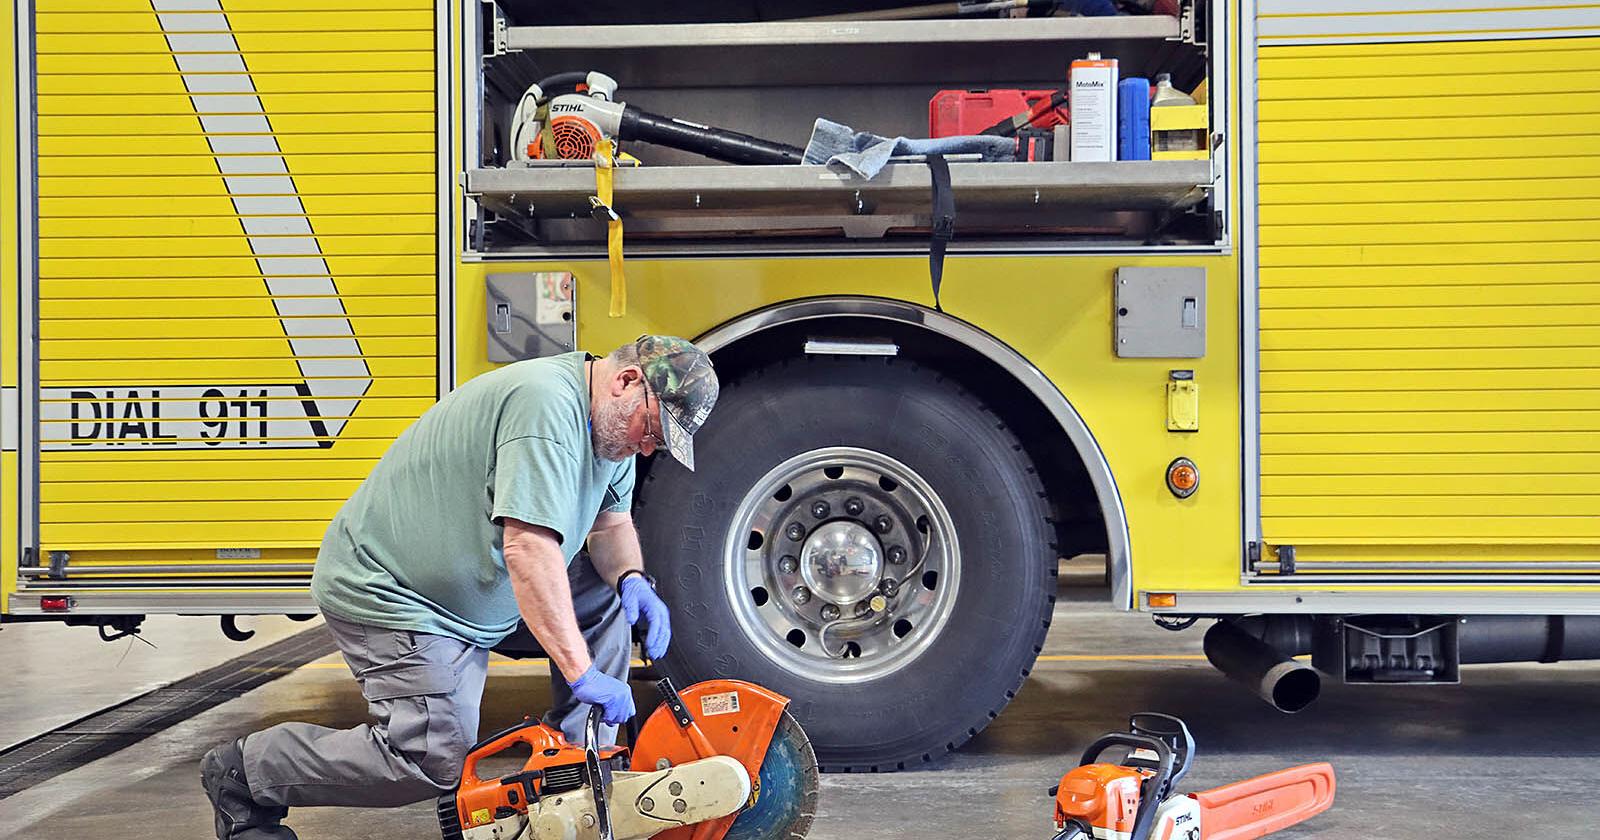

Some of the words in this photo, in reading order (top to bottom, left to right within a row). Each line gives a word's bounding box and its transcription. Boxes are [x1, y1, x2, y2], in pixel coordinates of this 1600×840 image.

[551, 104, 584, 112] STIHL
[71, 390, 177, 446] DIAL
[199, 388, 268, 446] 911
[1175, 811, 1193, 826] STIHL
